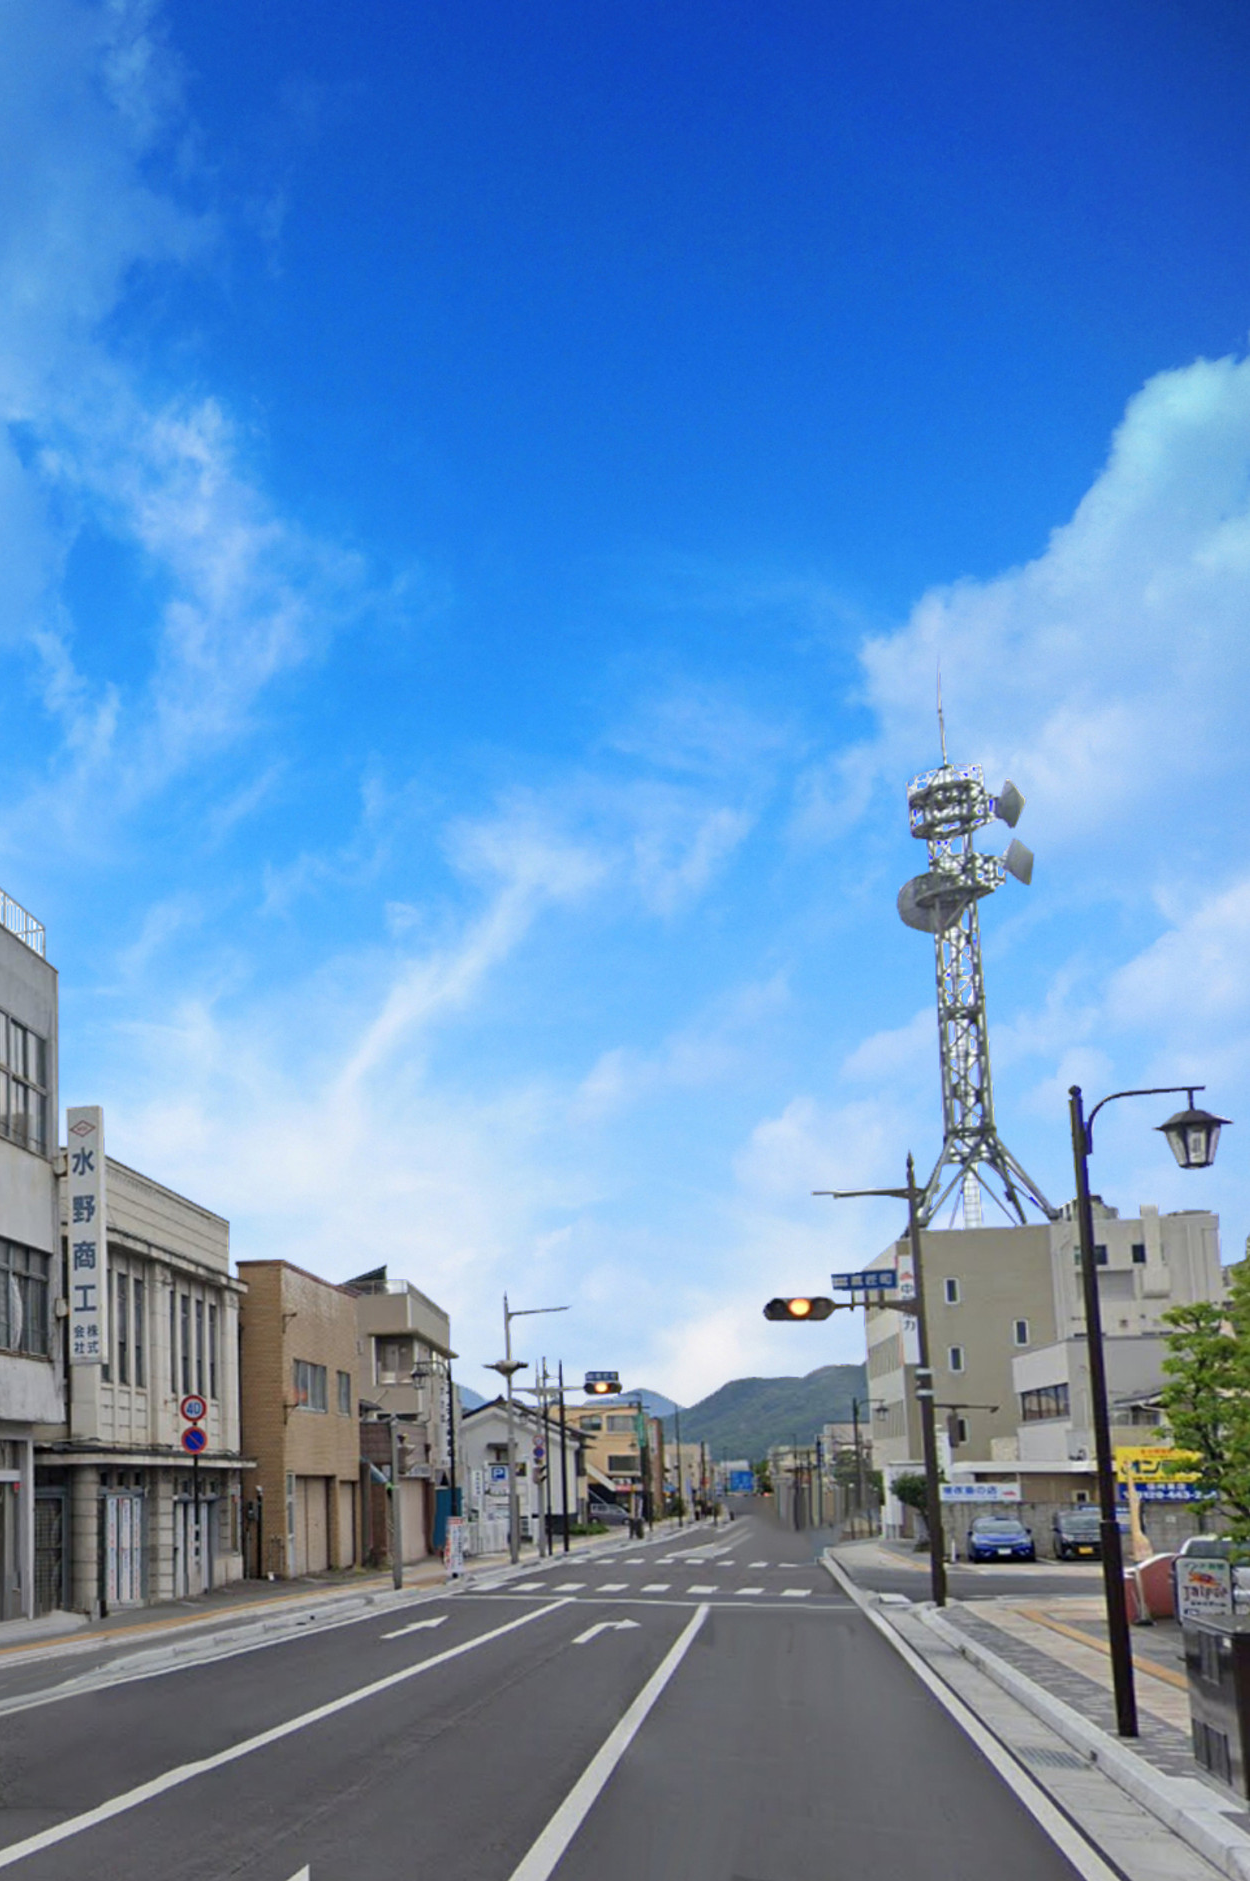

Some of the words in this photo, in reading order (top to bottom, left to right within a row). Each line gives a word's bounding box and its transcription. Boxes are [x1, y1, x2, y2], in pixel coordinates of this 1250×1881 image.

[72, 1147, 96, 1313] 水野商工
[186, 1403, 201, 1414] 40
